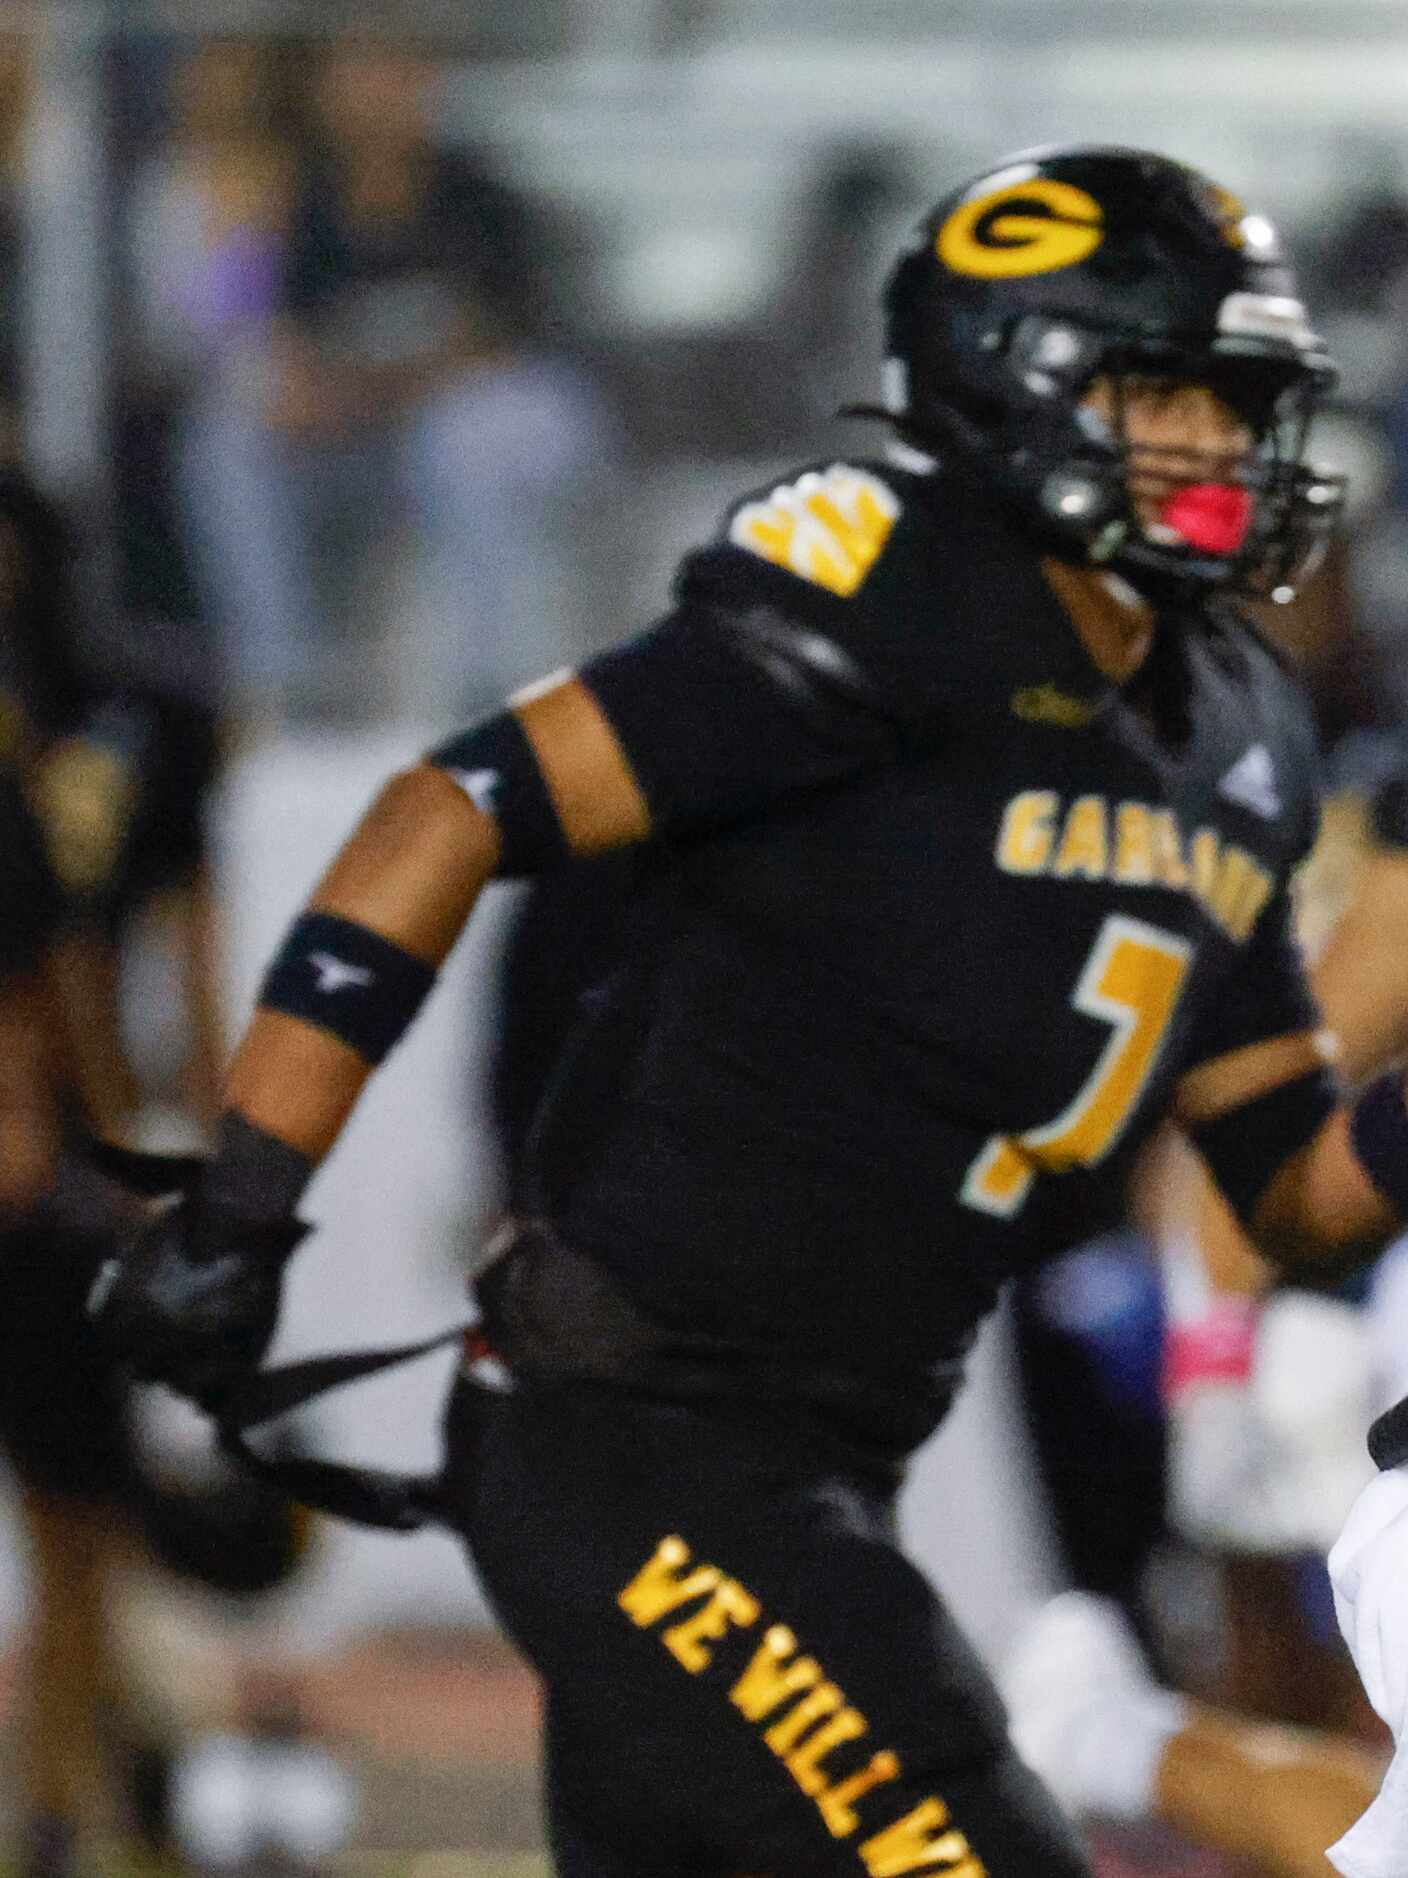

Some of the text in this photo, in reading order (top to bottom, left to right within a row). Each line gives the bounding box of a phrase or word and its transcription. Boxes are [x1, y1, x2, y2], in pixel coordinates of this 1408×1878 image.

[937, 178, 1105, 279] G
[958, 911, 1198, 1221] 7
[615, 1533, 989, 1878] WE WILL W
